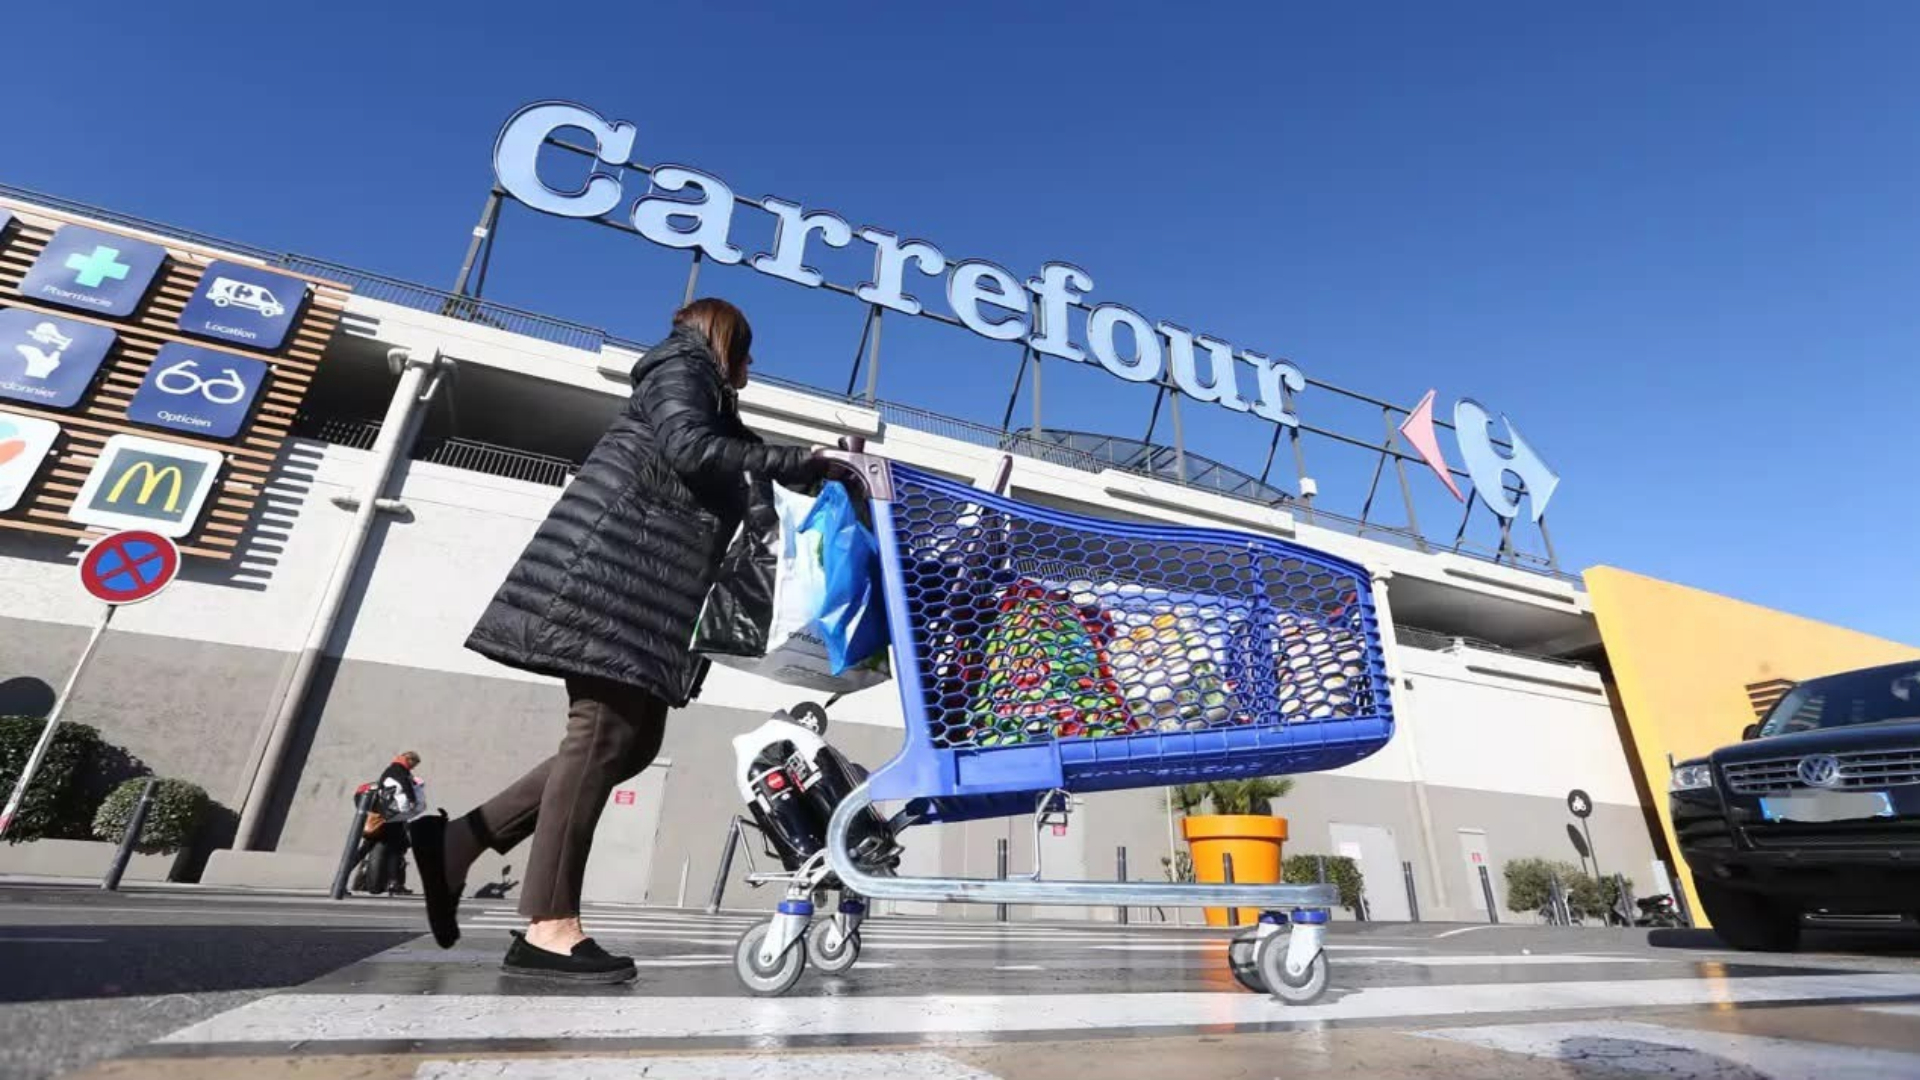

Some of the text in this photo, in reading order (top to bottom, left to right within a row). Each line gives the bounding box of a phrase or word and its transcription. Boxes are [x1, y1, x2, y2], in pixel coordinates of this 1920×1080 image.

[493, 100, 1306, 428] Carrefour
[205, 321, 256, 339] Location
[0, 381, 57, 399] donnier
[157, 410, 212, 427] Opticien
